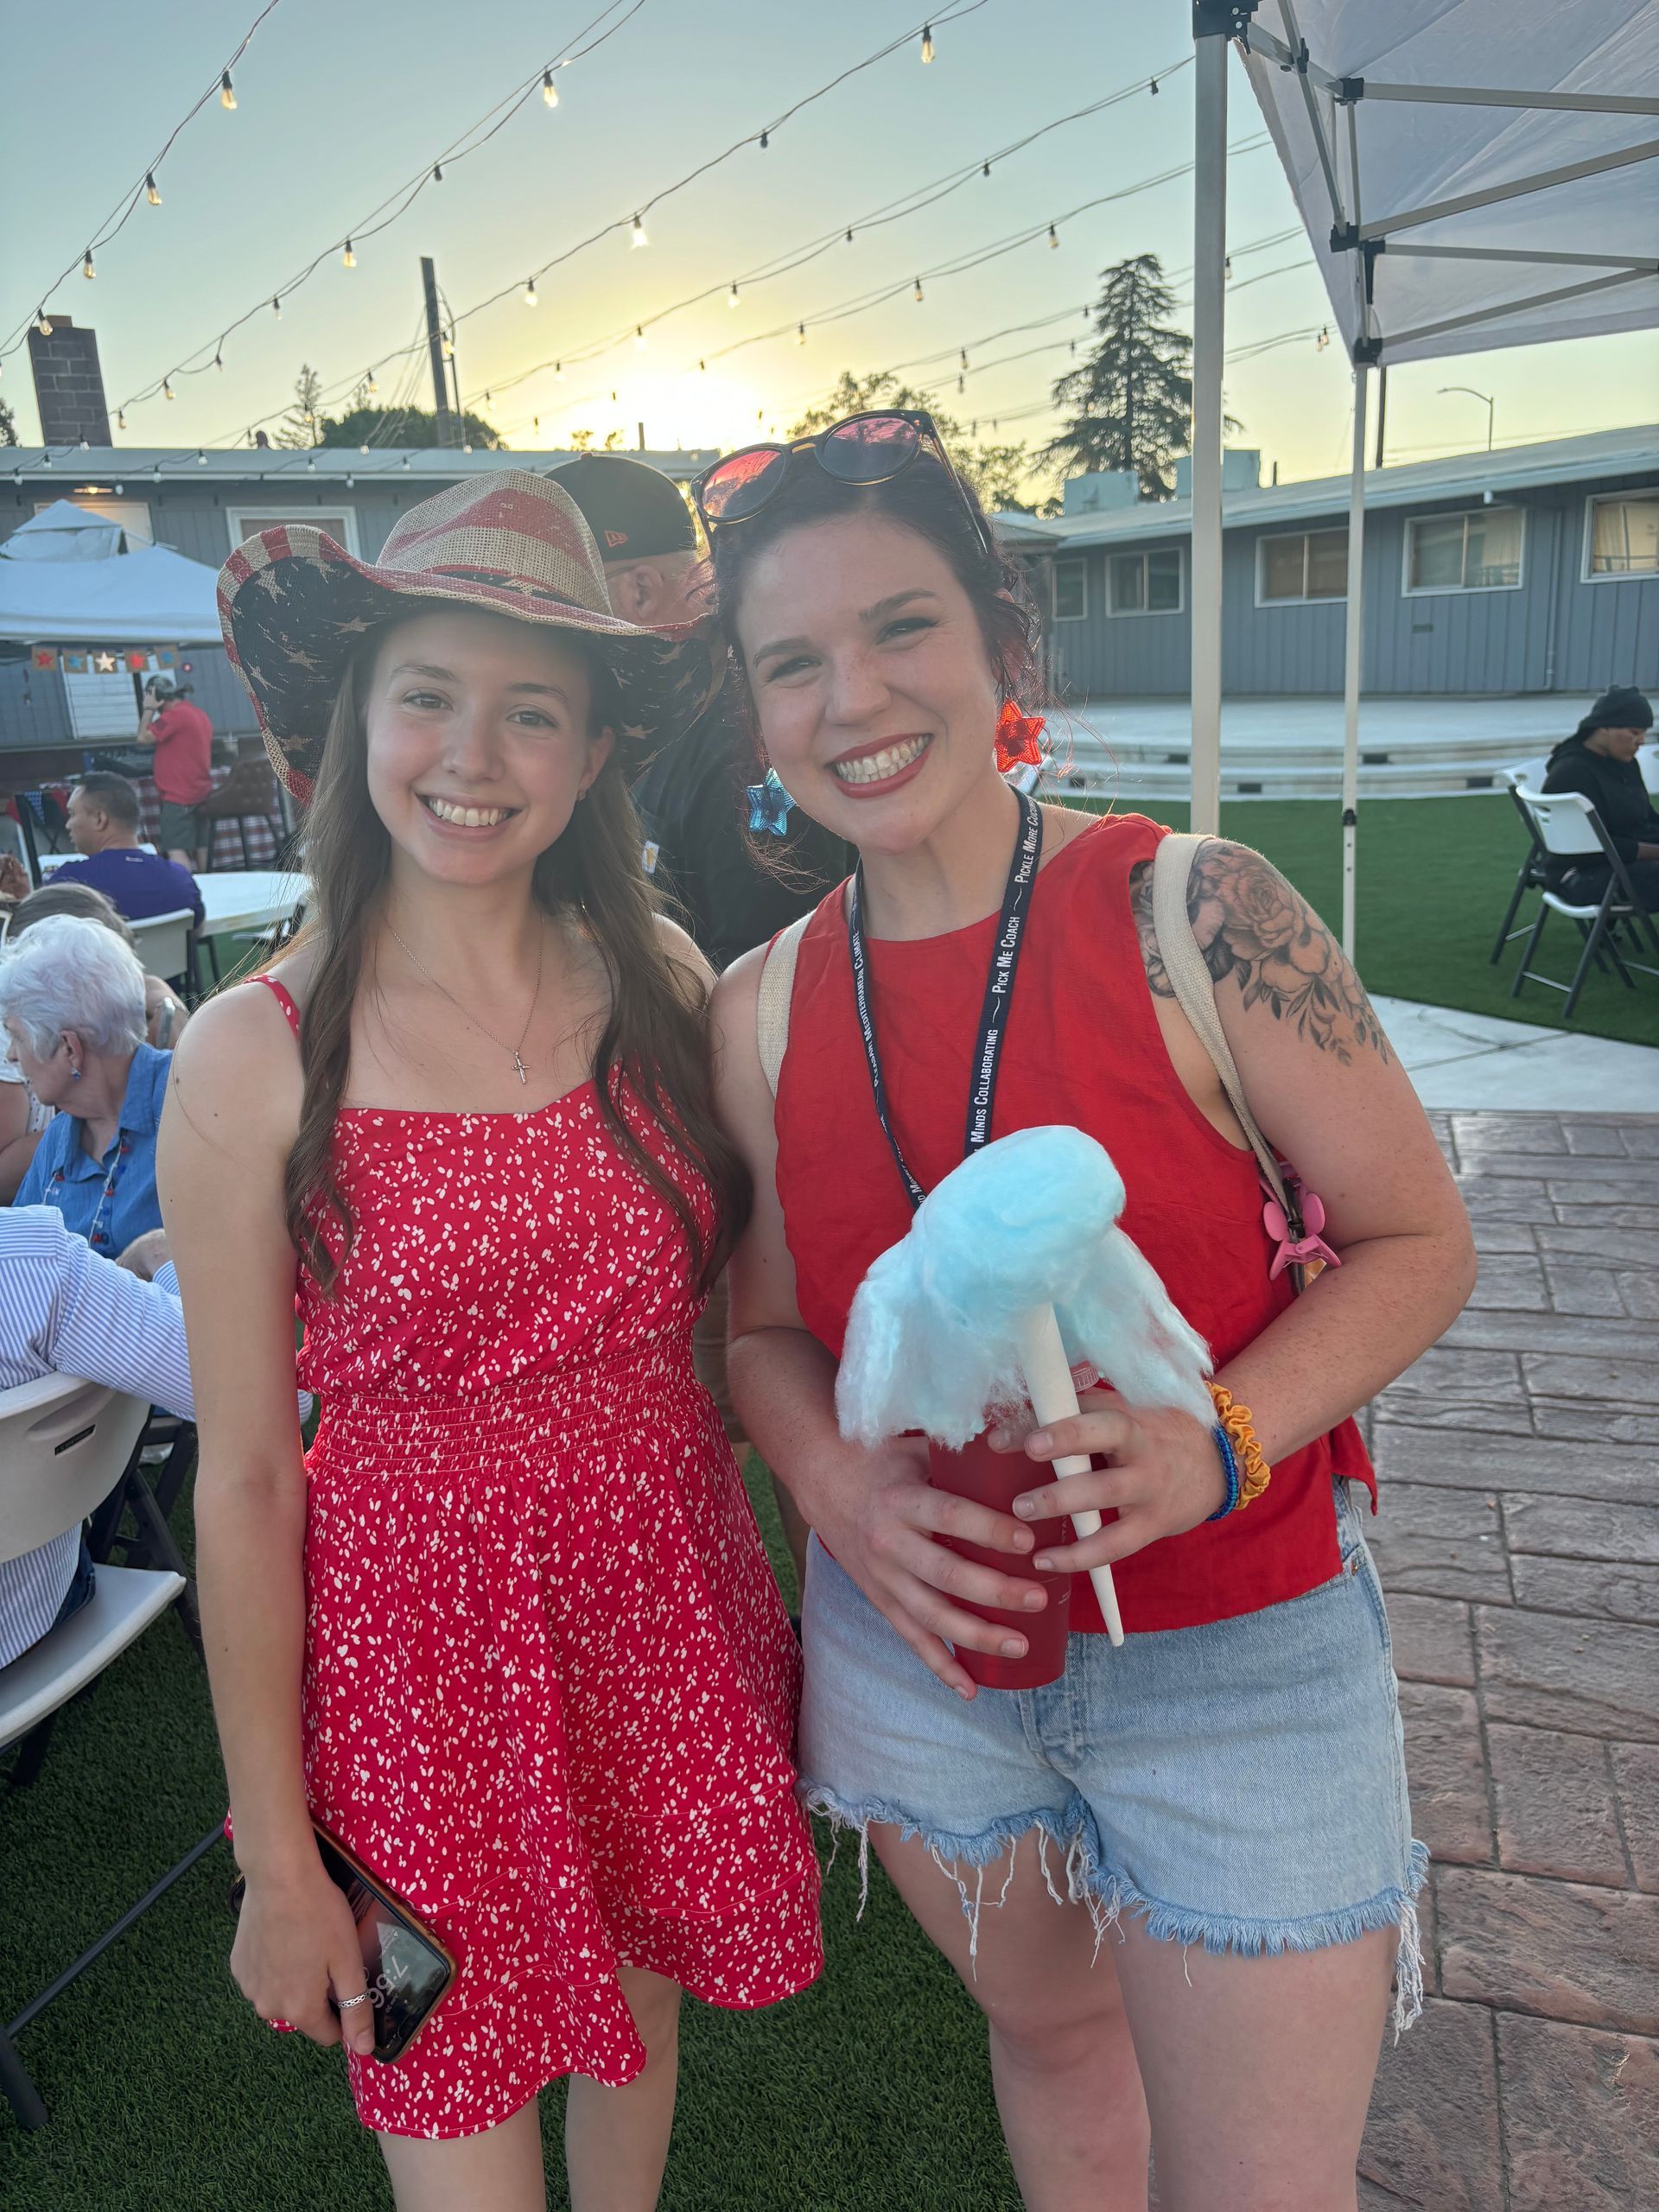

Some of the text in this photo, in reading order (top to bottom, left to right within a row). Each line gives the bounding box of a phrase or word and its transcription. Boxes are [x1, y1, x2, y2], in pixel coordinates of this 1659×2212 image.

[1022, 826, 1038, 853] MORE
[1014, 854, 1034, 883] PICKLE
[852, 930, 864, 970] CLIMATE
[992, 916, 1020, 994] PICK ME COACH
[856, 968, 873, 1042] MEDITERRANEAN
[970, 1029, 999, 1143] MINDS COLLABORATING
[365, 1955, 409, 2009] 7:56
